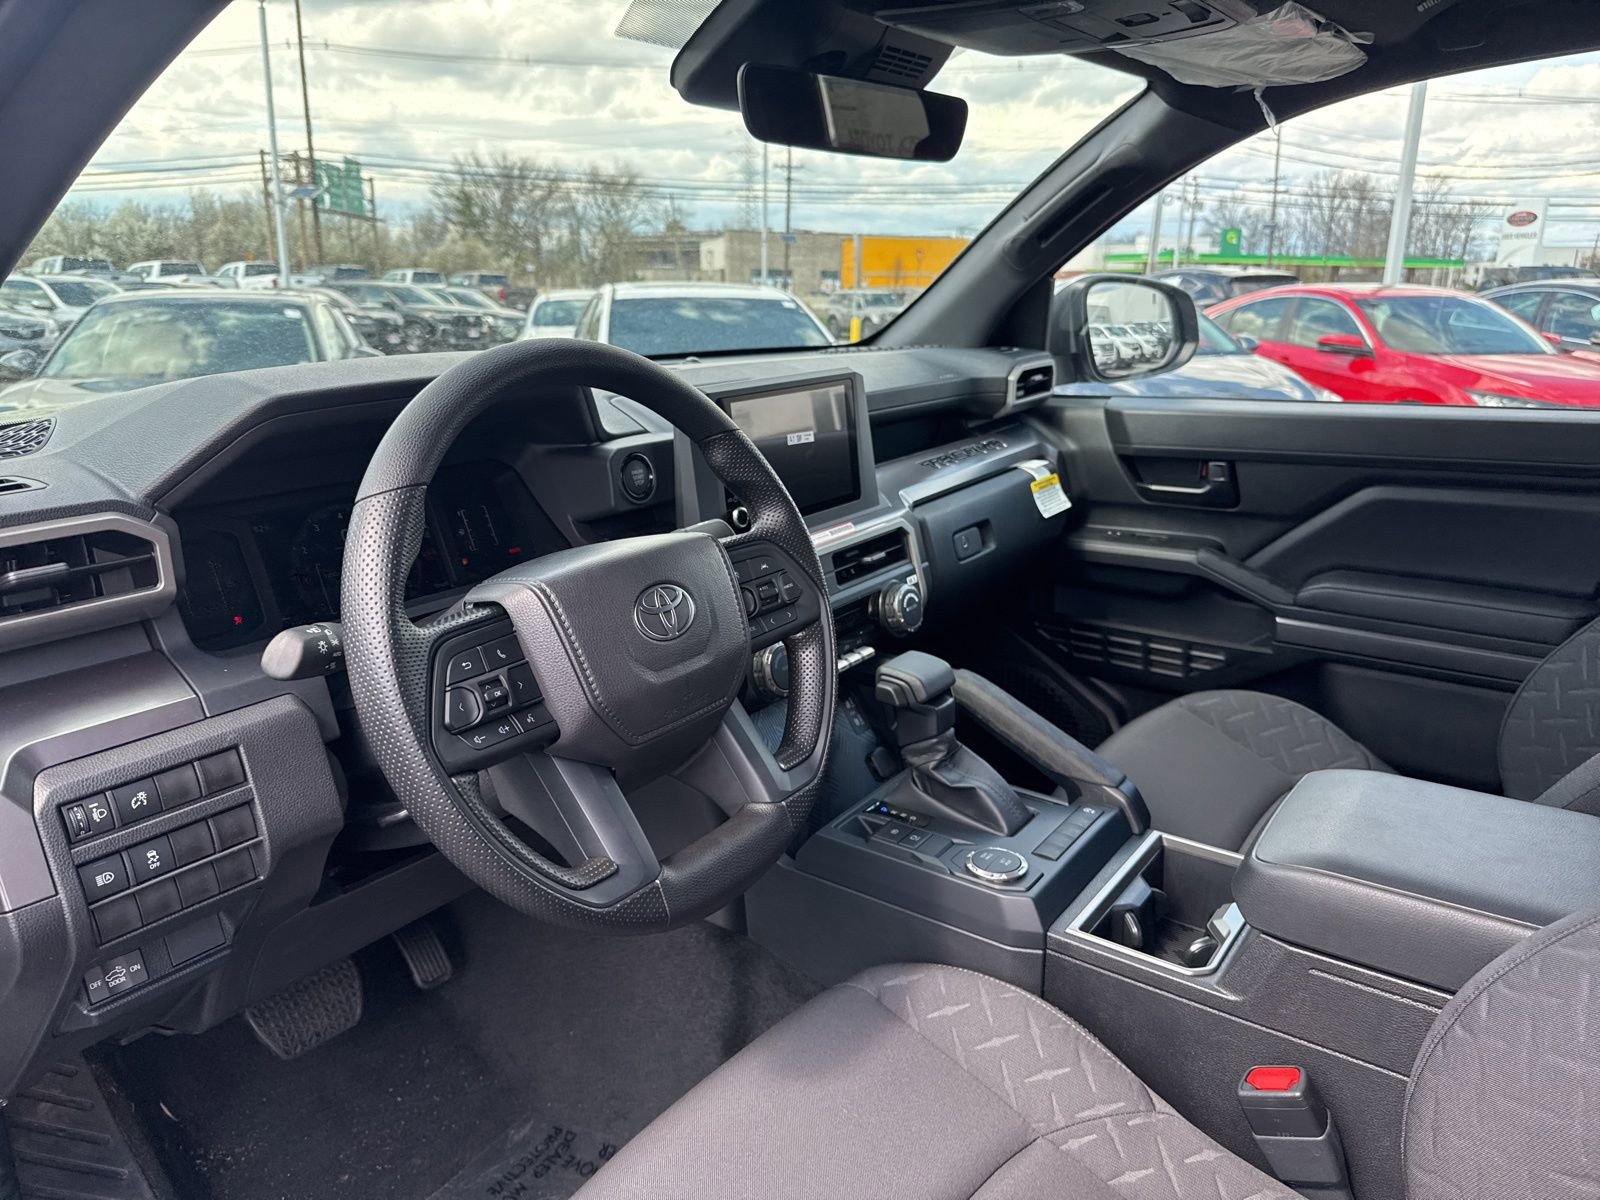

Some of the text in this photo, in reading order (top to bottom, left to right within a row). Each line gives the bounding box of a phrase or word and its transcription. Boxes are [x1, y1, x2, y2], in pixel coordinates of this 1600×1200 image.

[493, 689, 503, 698] OK
[149, 861, 161, 870] OFF
[129, 962, 141, 973] ON
[89, 979, 102, 991] OFF
[108, 975, 127, 988] DOOR
[532, 1129, 577, 1179] DEALER
[486, 1127, 562, 1196] PROTECTIVE
[560, 1153, 599, 1177] OVE
